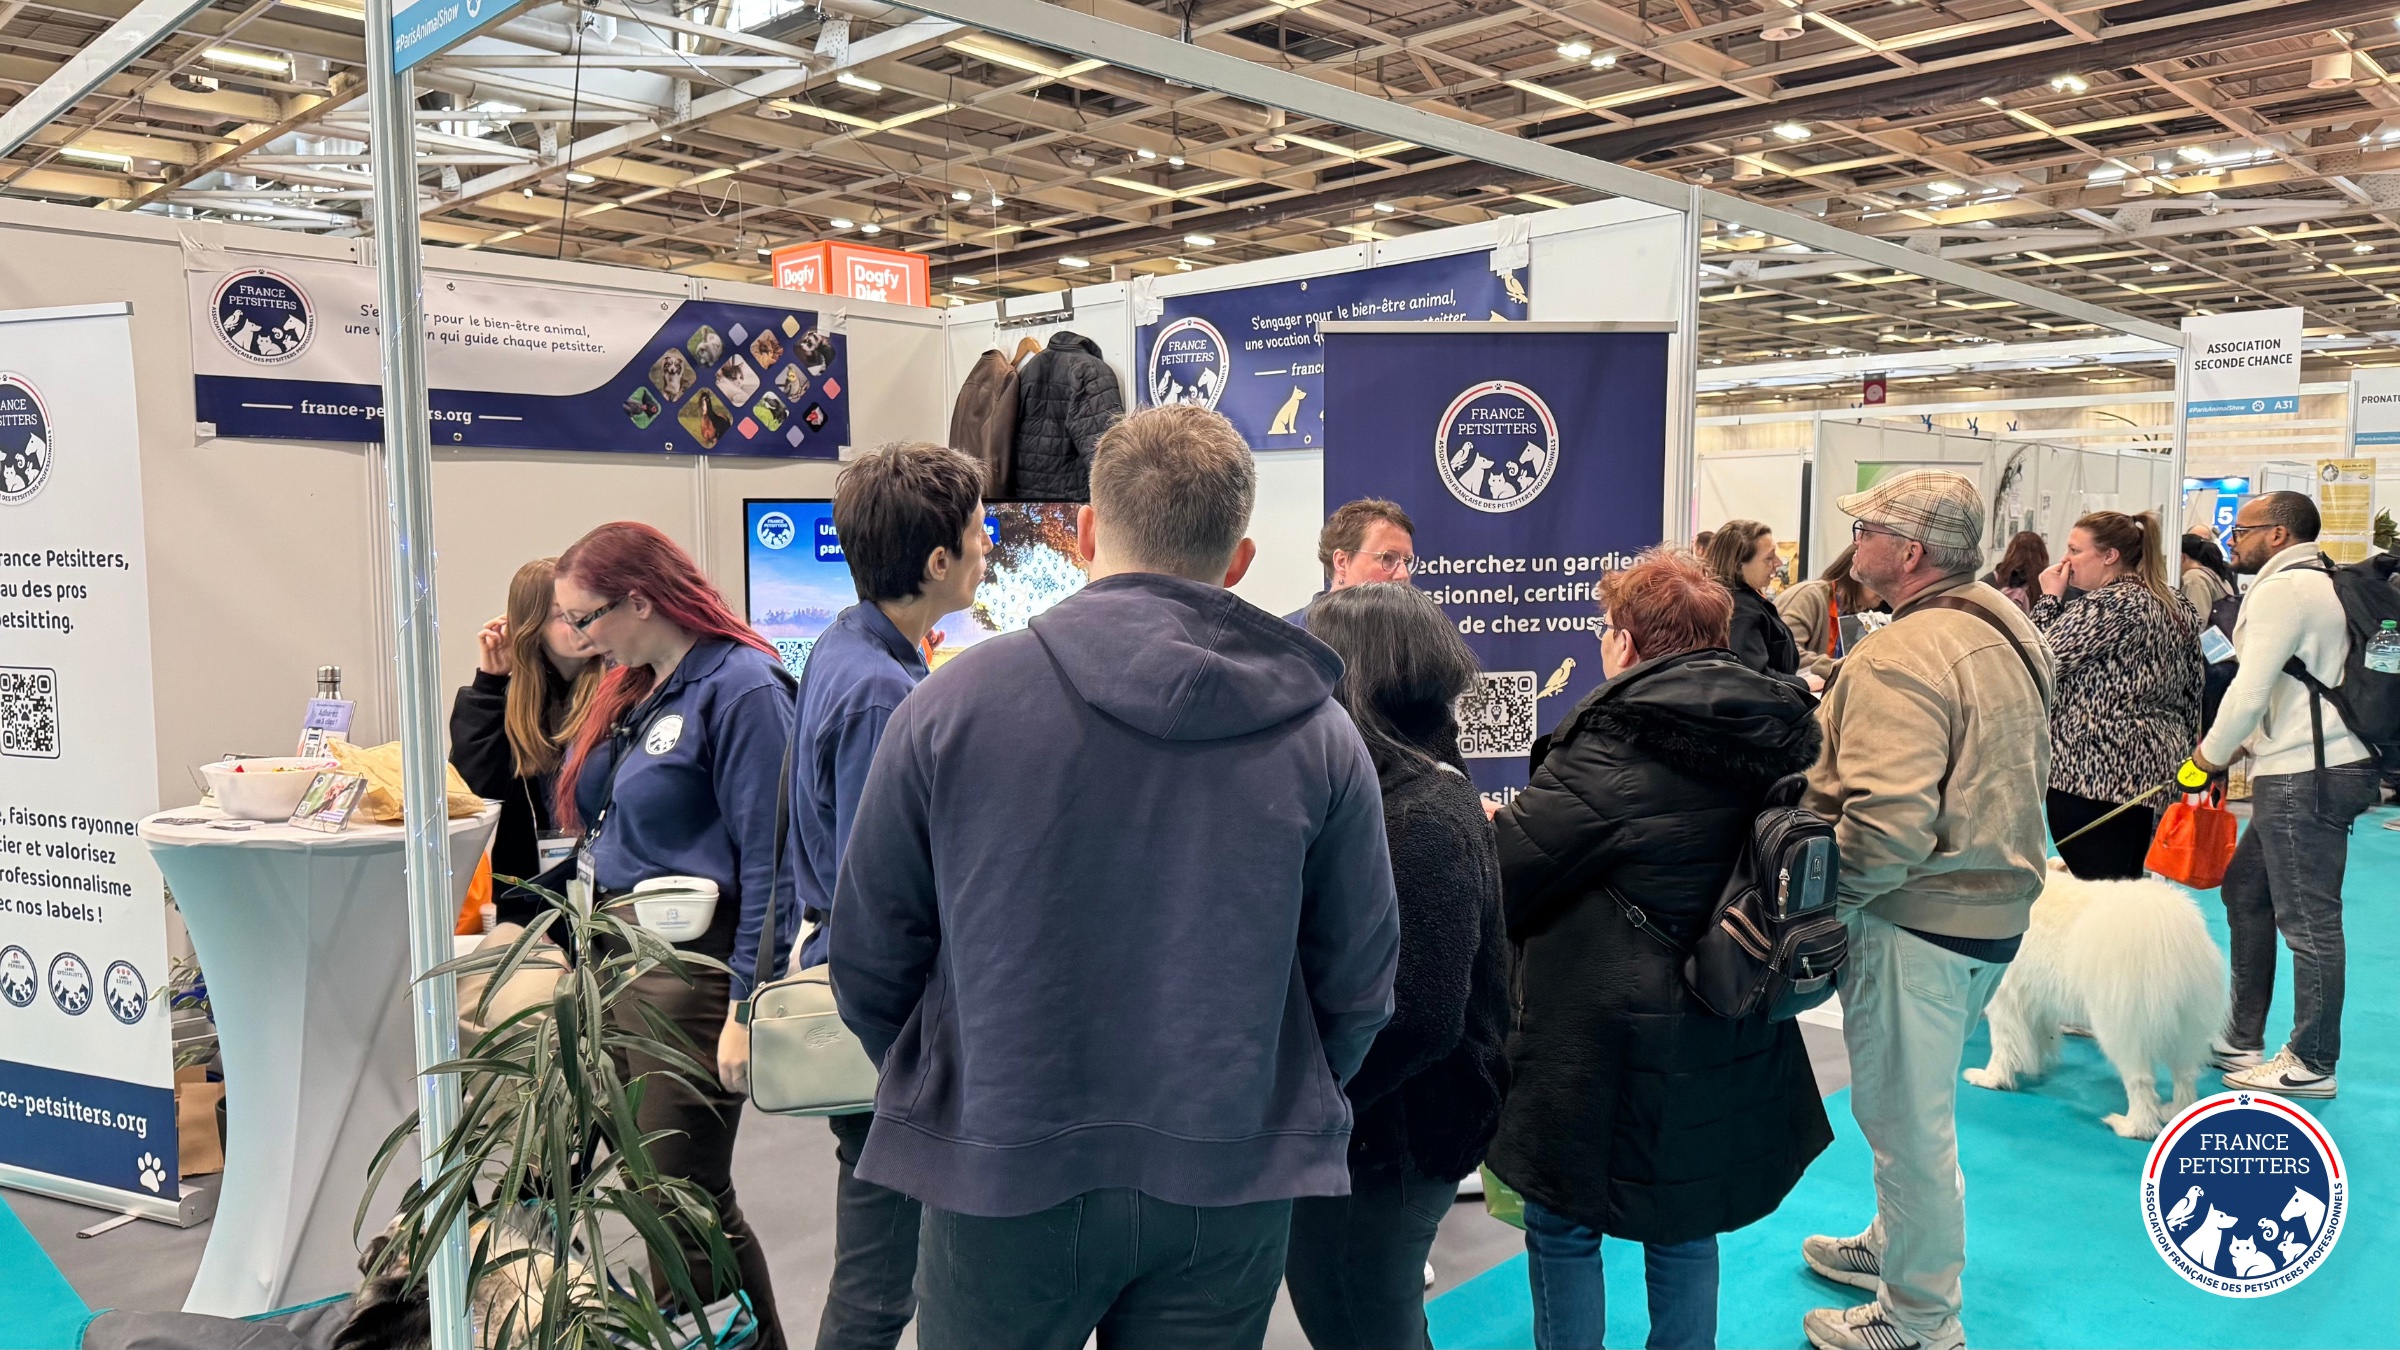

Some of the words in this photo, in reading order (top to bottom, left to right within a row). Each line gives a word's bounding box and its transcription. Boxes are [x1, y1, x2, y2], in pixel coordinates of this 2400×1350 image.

[395, 3, 459, 53] #ParisAnimalShow
[784, 265, 814, 286] Dogfy
[854, 264, 899, 289] Dogfy
[239, 285, 285, 298] FRANCE
[855, 283, 887, 302] Diet
[228, 295, 297, 310] PETSITTERS
[1251, 313, 1302, 331] S'engager
[1306, 311, 1333, 327] pour
[1337, 305, 1349, 319] le
[1352, 298, 1405, 317] bien-être
[1409, 289, 1456, 309] animal,
[434, 314, 464, 326] pour
[470, 315, 480, 328] le
[484, 316, 540, 333] bien-être
[544, 325, 590, 338] animal,
[345, 325, 370, 335] une
[440, 331, 460, 345] qui
[464, 333, 499, 347] guide
[503, 335, 547, 350] chaque
[551, 340, 606, 354] petsitter.
[1168, 340, 1207, 351] FRANCE
[1245, 339, 1263, 350] une
[1266, 334, 1310, 348] vocation
[2207, 339, 2281, 354] ASSOCIATION
[1161, 352, 1215, 365] PETSITTERS
[2194, 357, 2245, 371] SECONDE
[2247, 353, 2293, 367] CHANCE
[0, 399, 27, 411] ANCE
[1471, 407, 1525, 420] FRANCE
[2189, 405, 2246, 413] #ParisAnimalShow
[2274, 401, 2292, 410] A31
[1458, 422, 1537, 435] PETSITTERS
[1439, 440, 1454, 485] ASSOCIATION
[1451, 483, 1482, 507] FRANÇAISE
[1497, 492, 1533, 509] PETSITTERS
[1532, 439, 1556, 494] PROFESSIONNELS
[2217, 506, 2233, 525] 5
[47, 549, 129, 570] Petsitters,
[1418, 555, 1526, 575] echerchez
[1532, 556, 1557, 571] un
[22, 580, 52, 597] des
[57, 585, 87, 602] pros
[0, 610, 74, 634] etsitting.
[1459, 615, 1485, 634] de
[1491, 615, 1540, 633] chez
[10, 806, 66, 828] faisons
[26, 840, 41, 856] et
[45, 841, 116, 864] valorisez
[0, 866, 131, 897] rofessionnalisme
[16, 900, 42, 915] nos
[47, 900, 94, 921] labels
[98, 906, 102, 923] !
[0, 1090, 147, 1139] ce-petsitters.org
